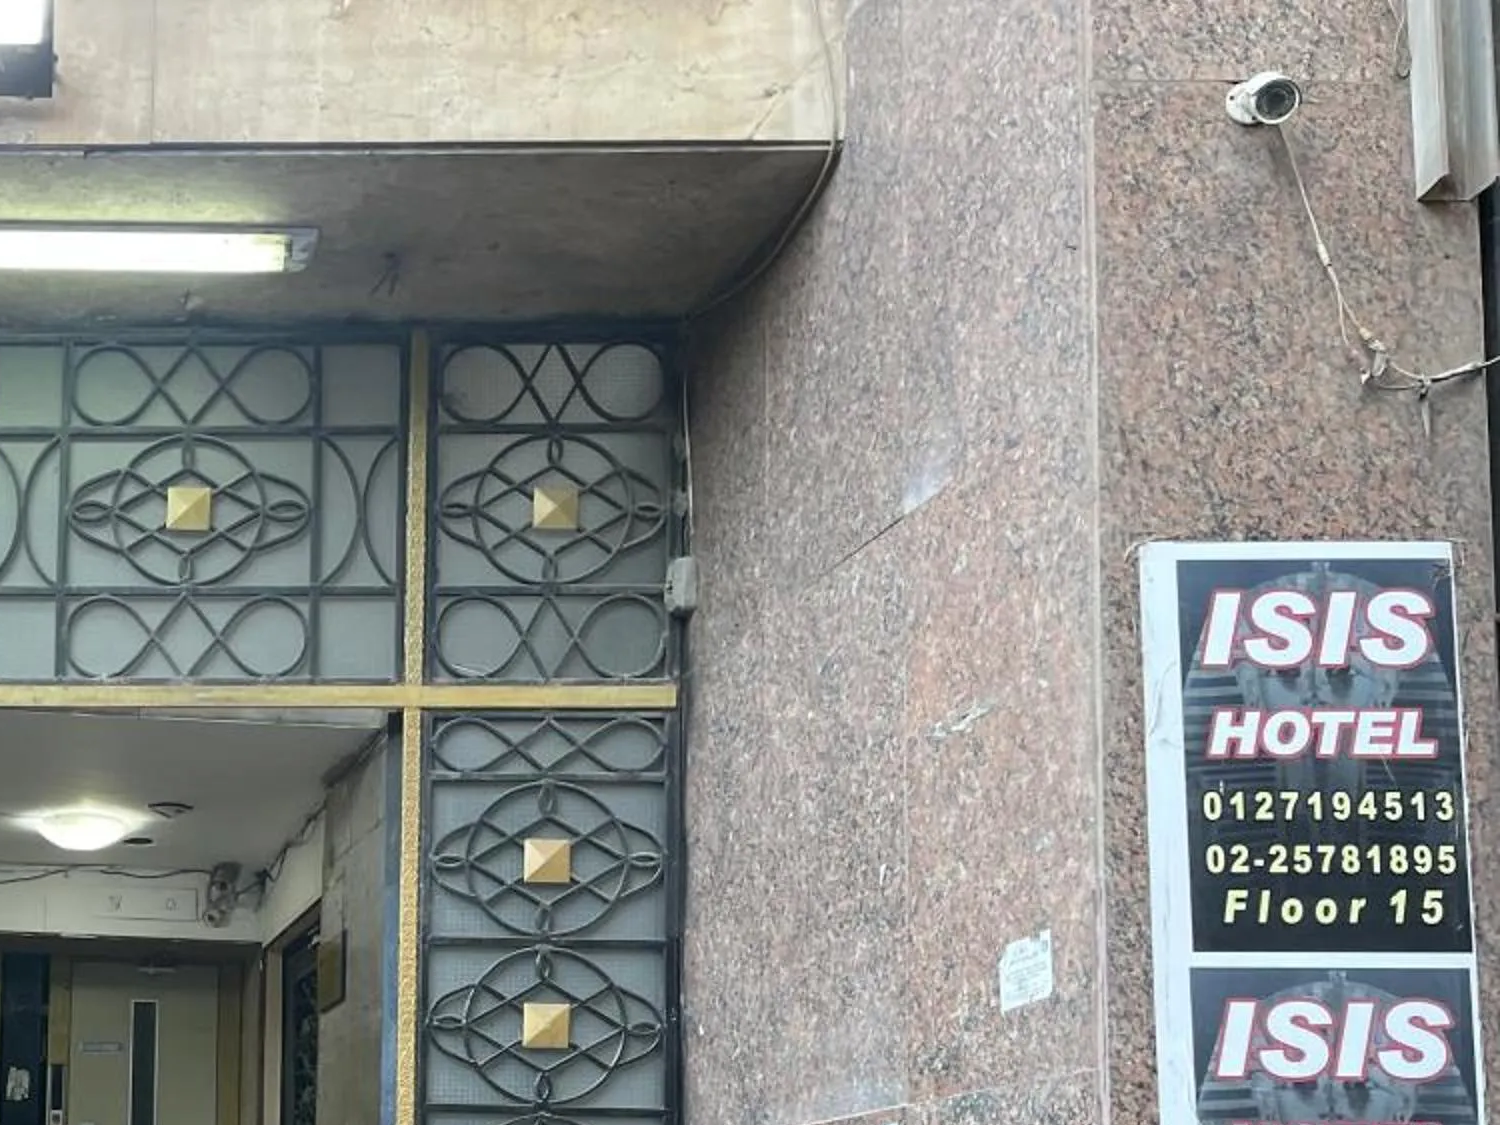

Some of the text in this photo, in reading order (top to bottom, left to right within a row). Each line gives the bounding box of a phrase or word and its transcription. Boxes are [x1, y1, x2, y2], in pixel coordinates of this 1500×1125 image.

[1201, 589, 1434, 668] ISIS
[1207, 709, 1439, 759] HOTEL
[1203, 790, 1454, 822] 0127194513
[1205, 844, 1457, 875] 02-25781895
[1223, 889, 1445, 926] Floor 15
[1216, 997, 1454, 1081] ISIS
